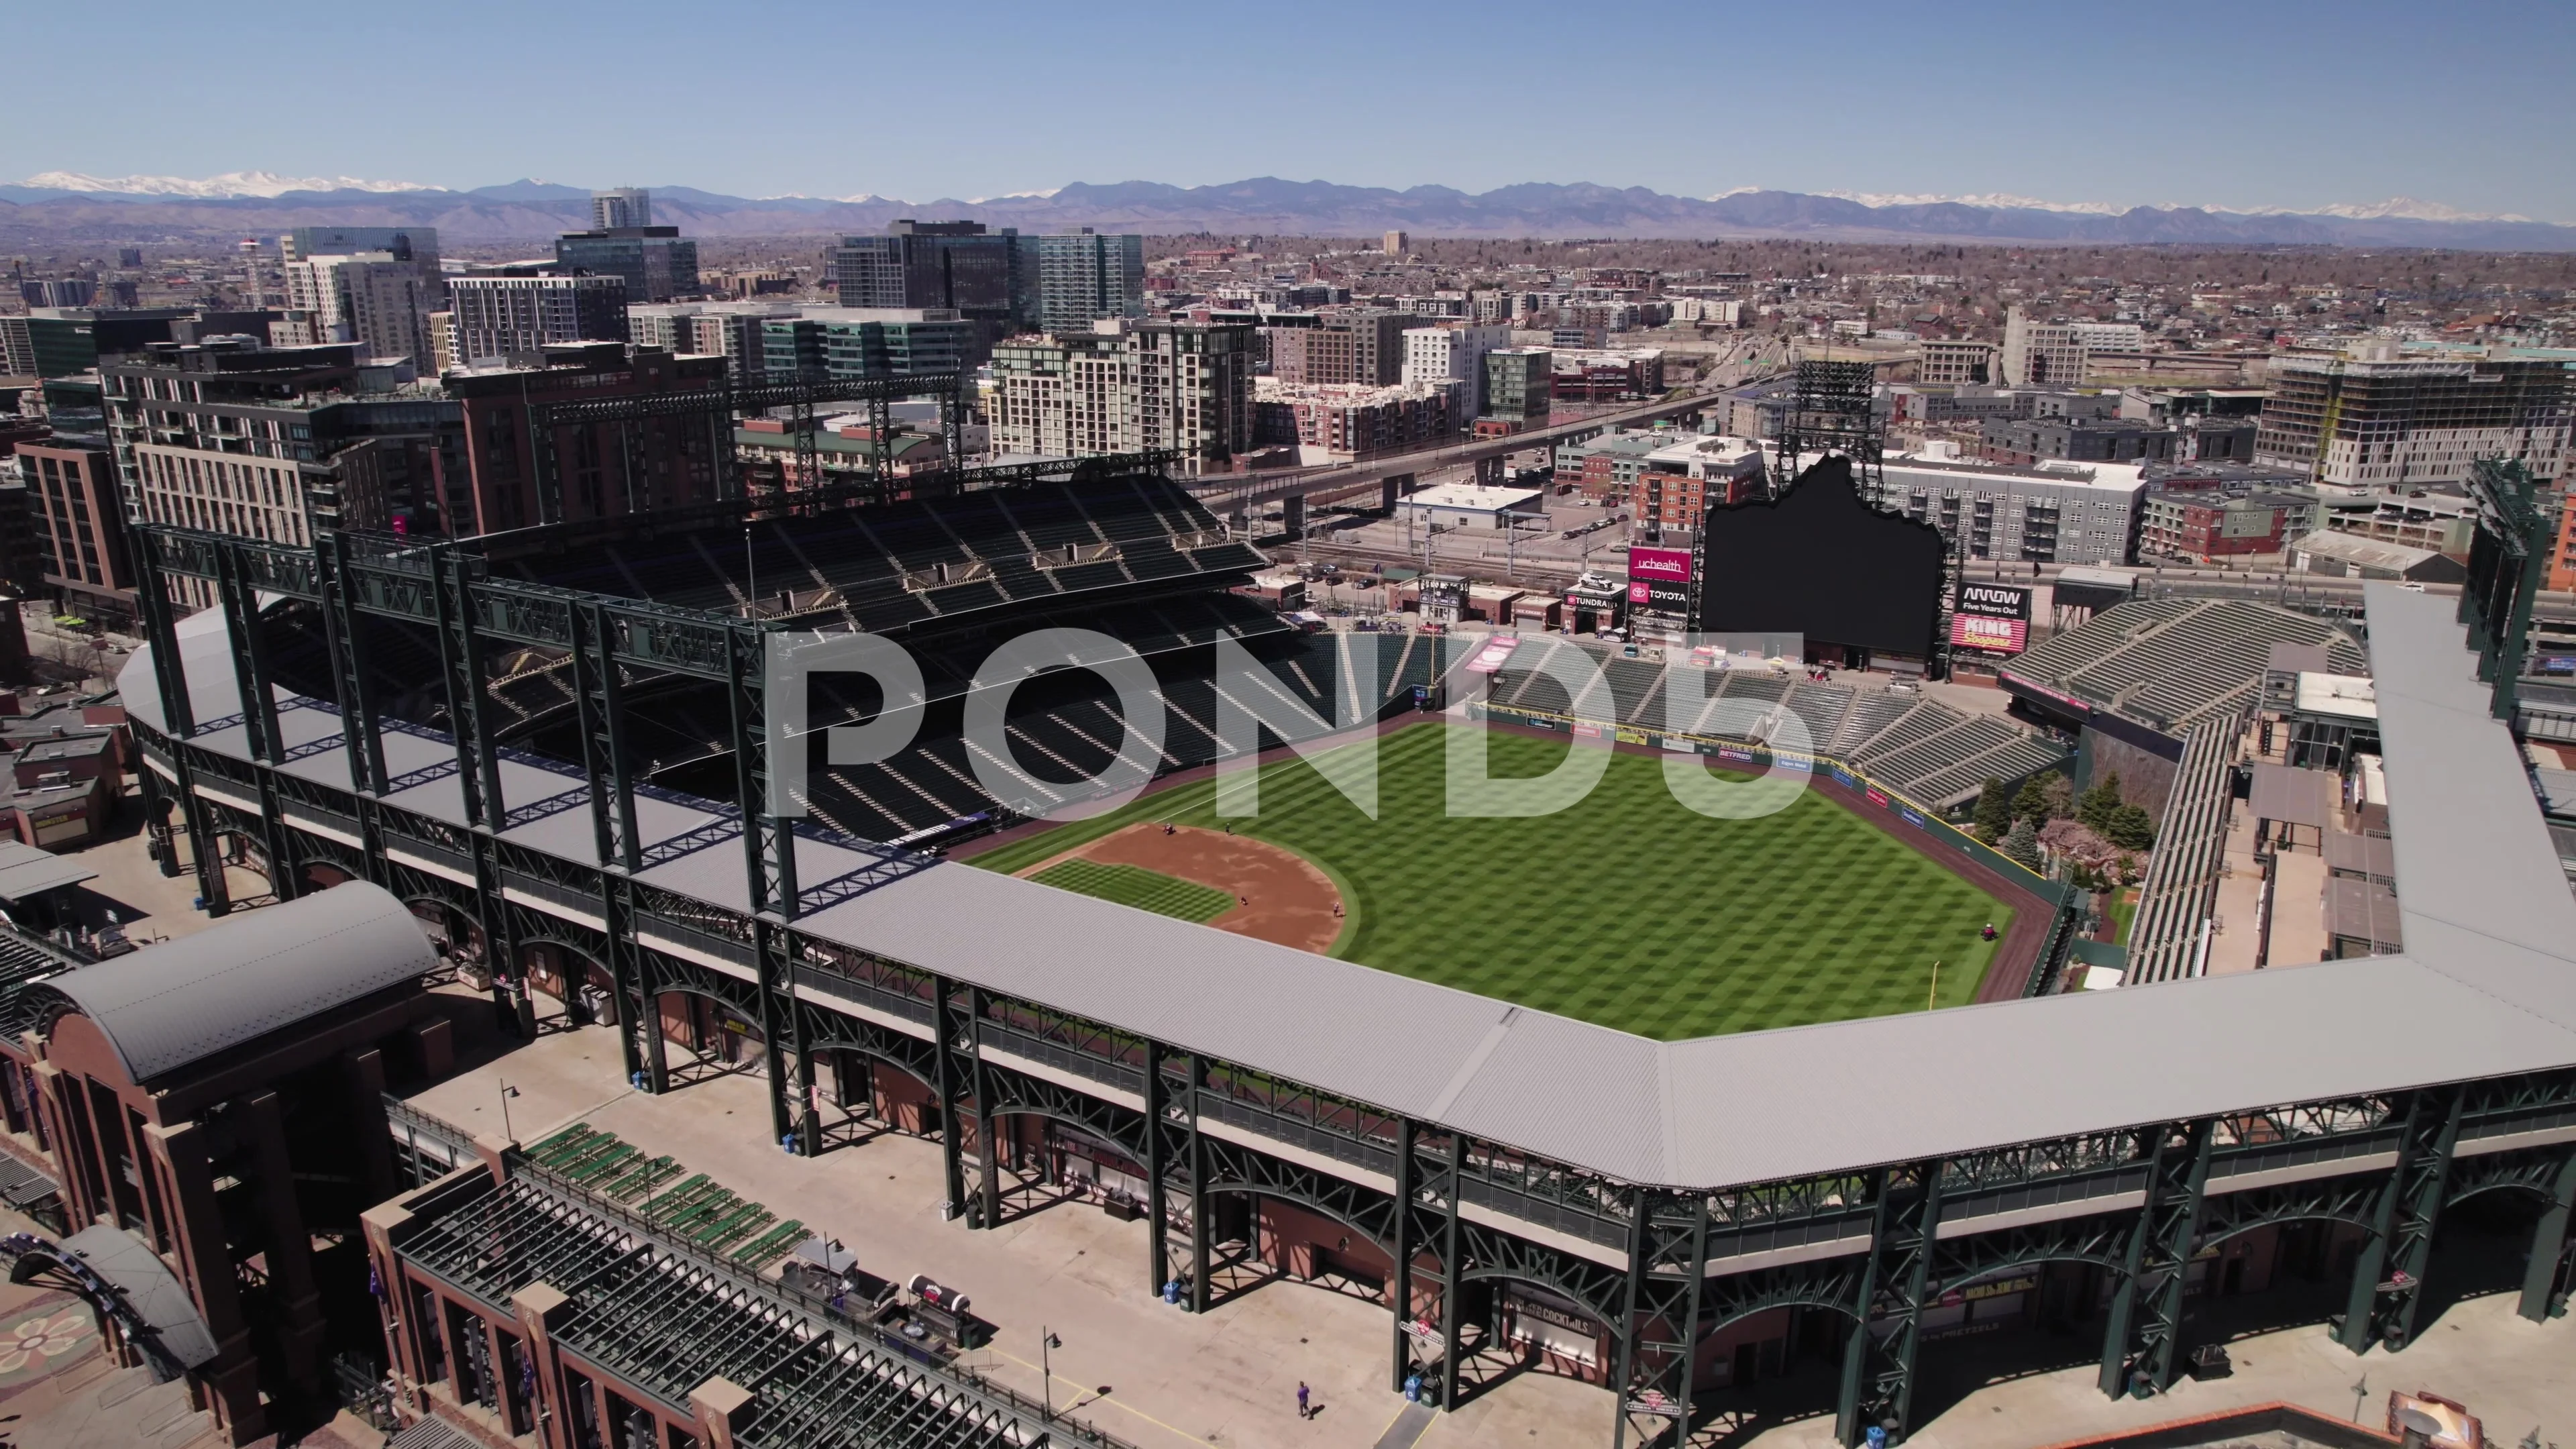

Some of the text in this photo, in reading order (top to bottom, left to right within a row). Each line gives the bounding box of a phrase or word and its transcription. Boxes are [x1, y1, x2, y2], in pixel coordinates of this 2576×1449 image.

[1638, 558, 1680, 572] uchealth
[1649, 590, 1686, 602] TOYOTA
[1964, 587, 2021, 604] ARROW
[1576, 597, 1607, 608] TUNDRA
[1963, 602, 1979, 610] Five
[1980, 604, 2002, 613] Years
[1965, 619, 2011, 635] KING
[1720, 750, 1751, 760] BETFRED
